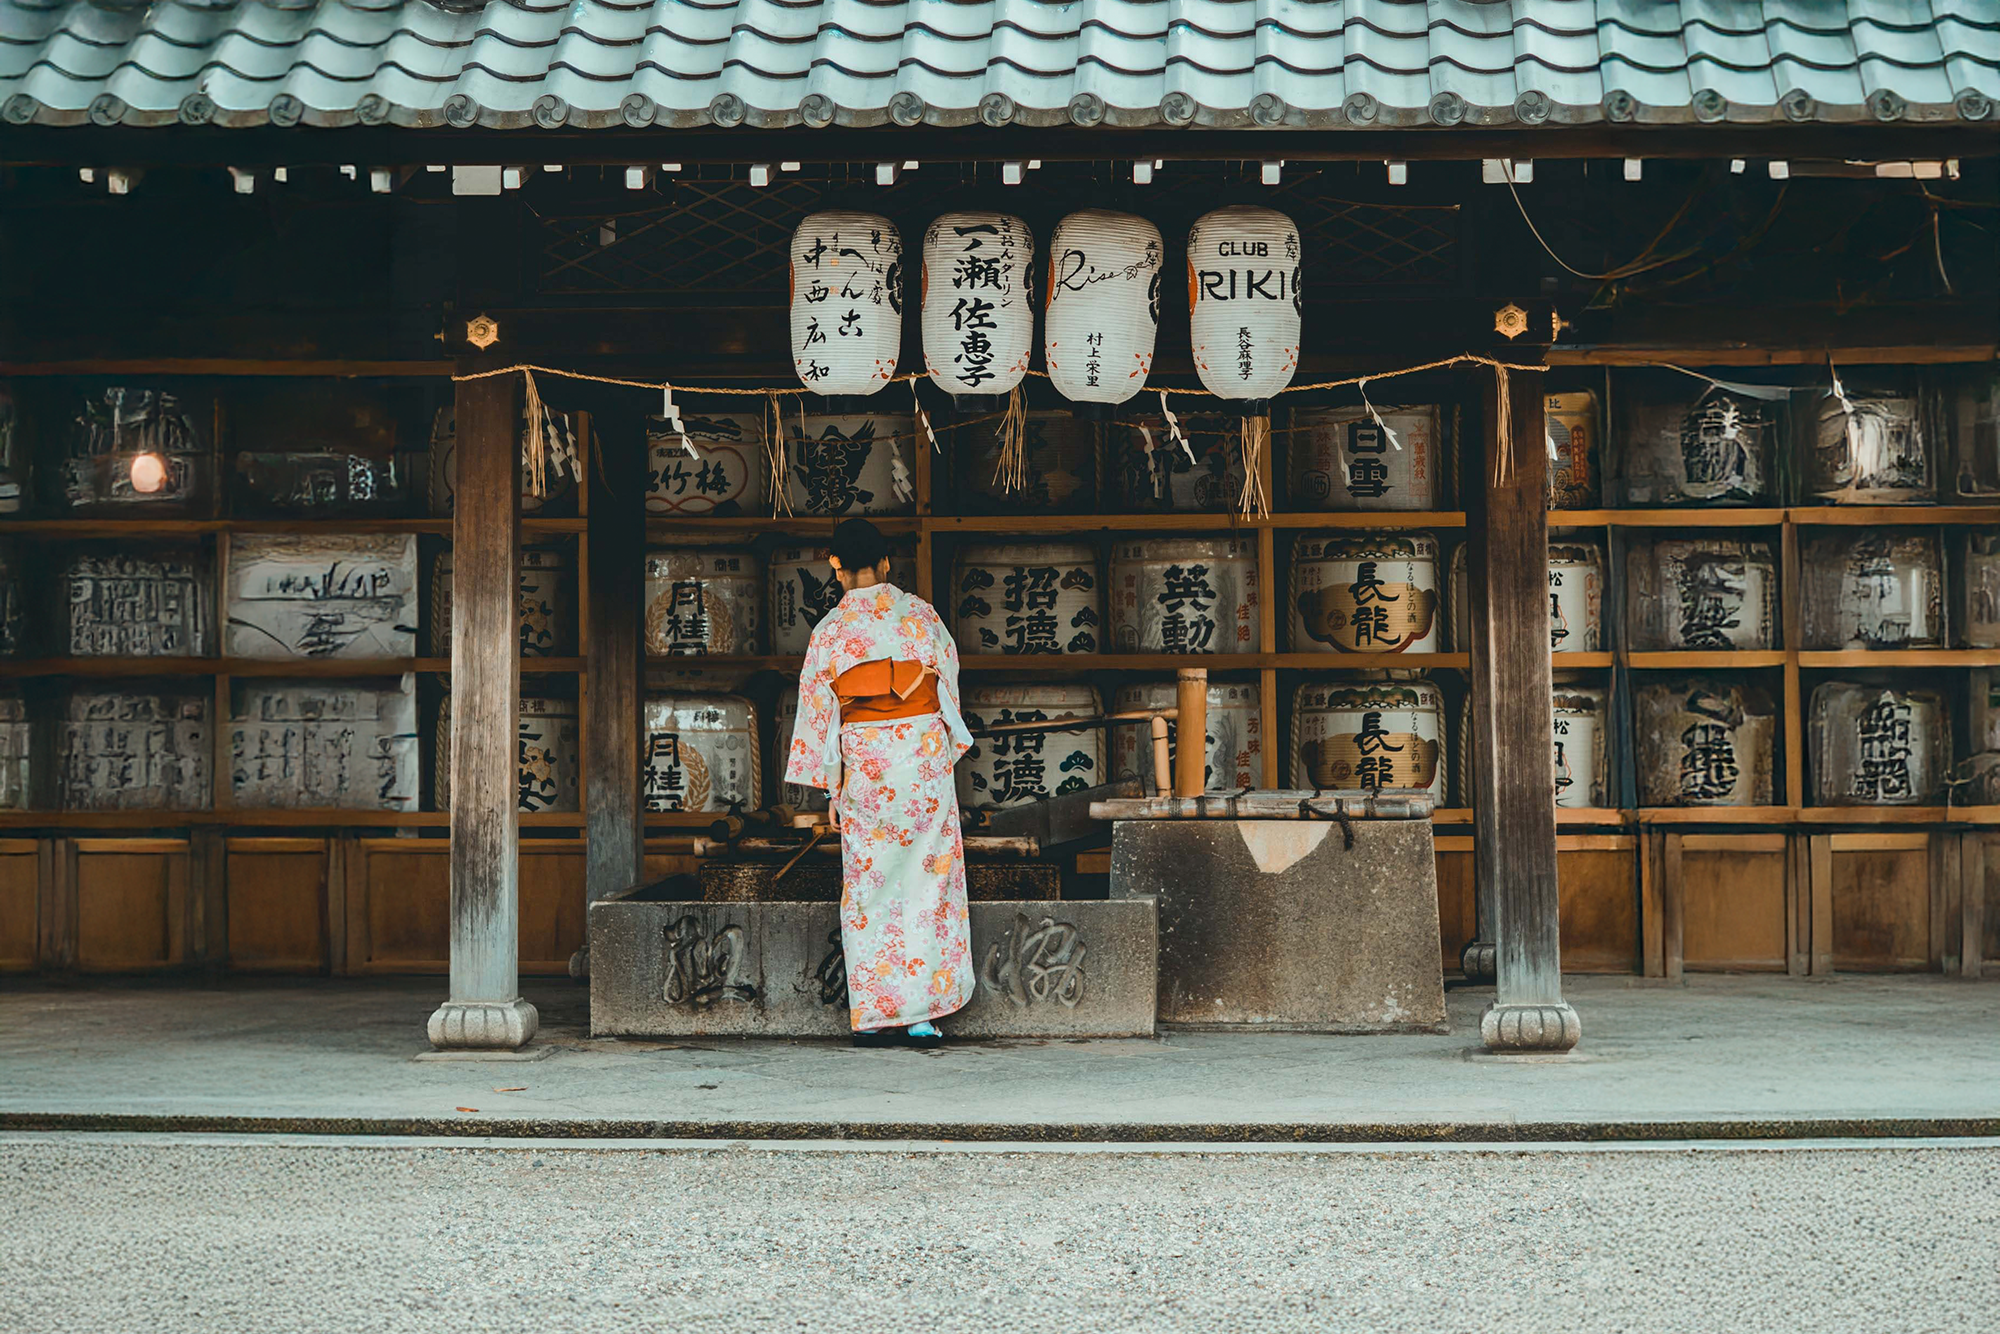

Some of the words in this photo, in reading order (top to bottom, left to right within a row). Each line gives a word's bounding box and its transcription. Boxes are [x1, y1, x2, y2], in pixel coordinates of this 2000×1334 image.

[1218, 241, 1269, 257] CLUB
[1198, 269, 1286, 301] RIKI
[1085, 332, 1104, 387] 村上栄里
[1346, 418, 1395, 497] 白雪
[1348, 562, 1400, 647] 長龍
